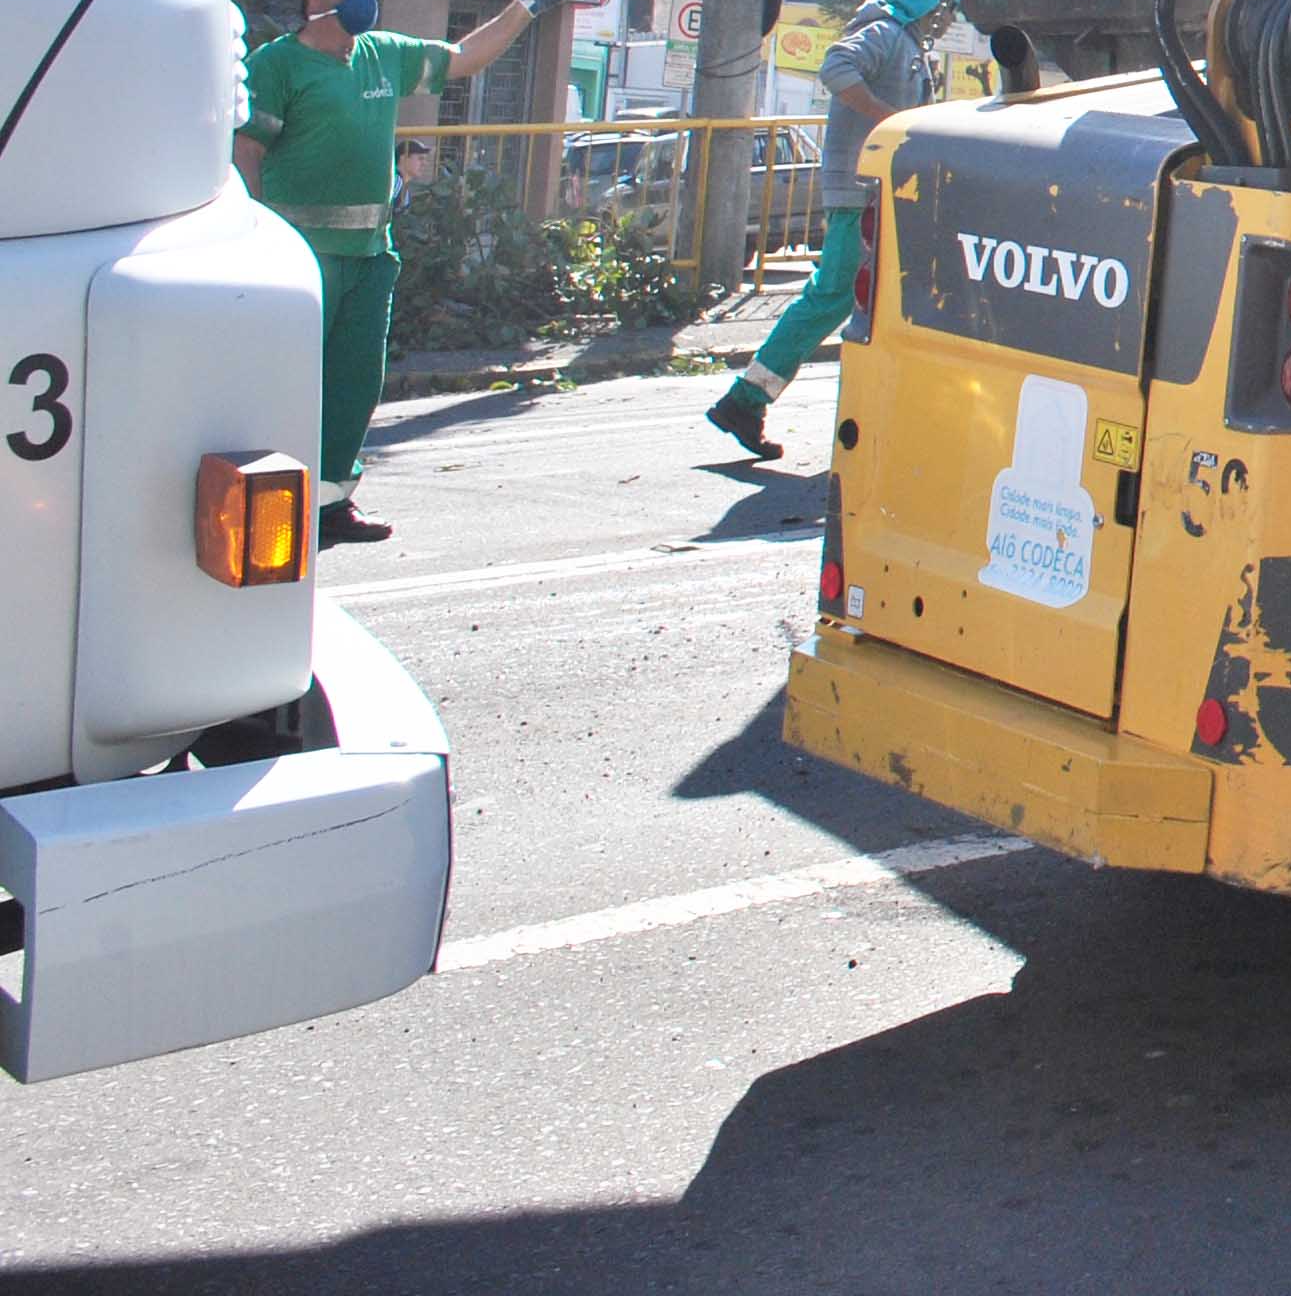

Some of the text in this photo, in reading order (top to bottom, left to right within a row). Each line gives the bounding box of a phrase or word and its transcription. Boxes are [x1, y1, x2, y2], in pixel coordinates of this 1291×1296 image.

[687, 8, 702, 32] E
[957, 232, 1129, 309] VOLVO
[6, 353, 73, 461] 3
[990, 531, 1016, 558] Alô
[1021, 540, 1084, 578] CODECA
